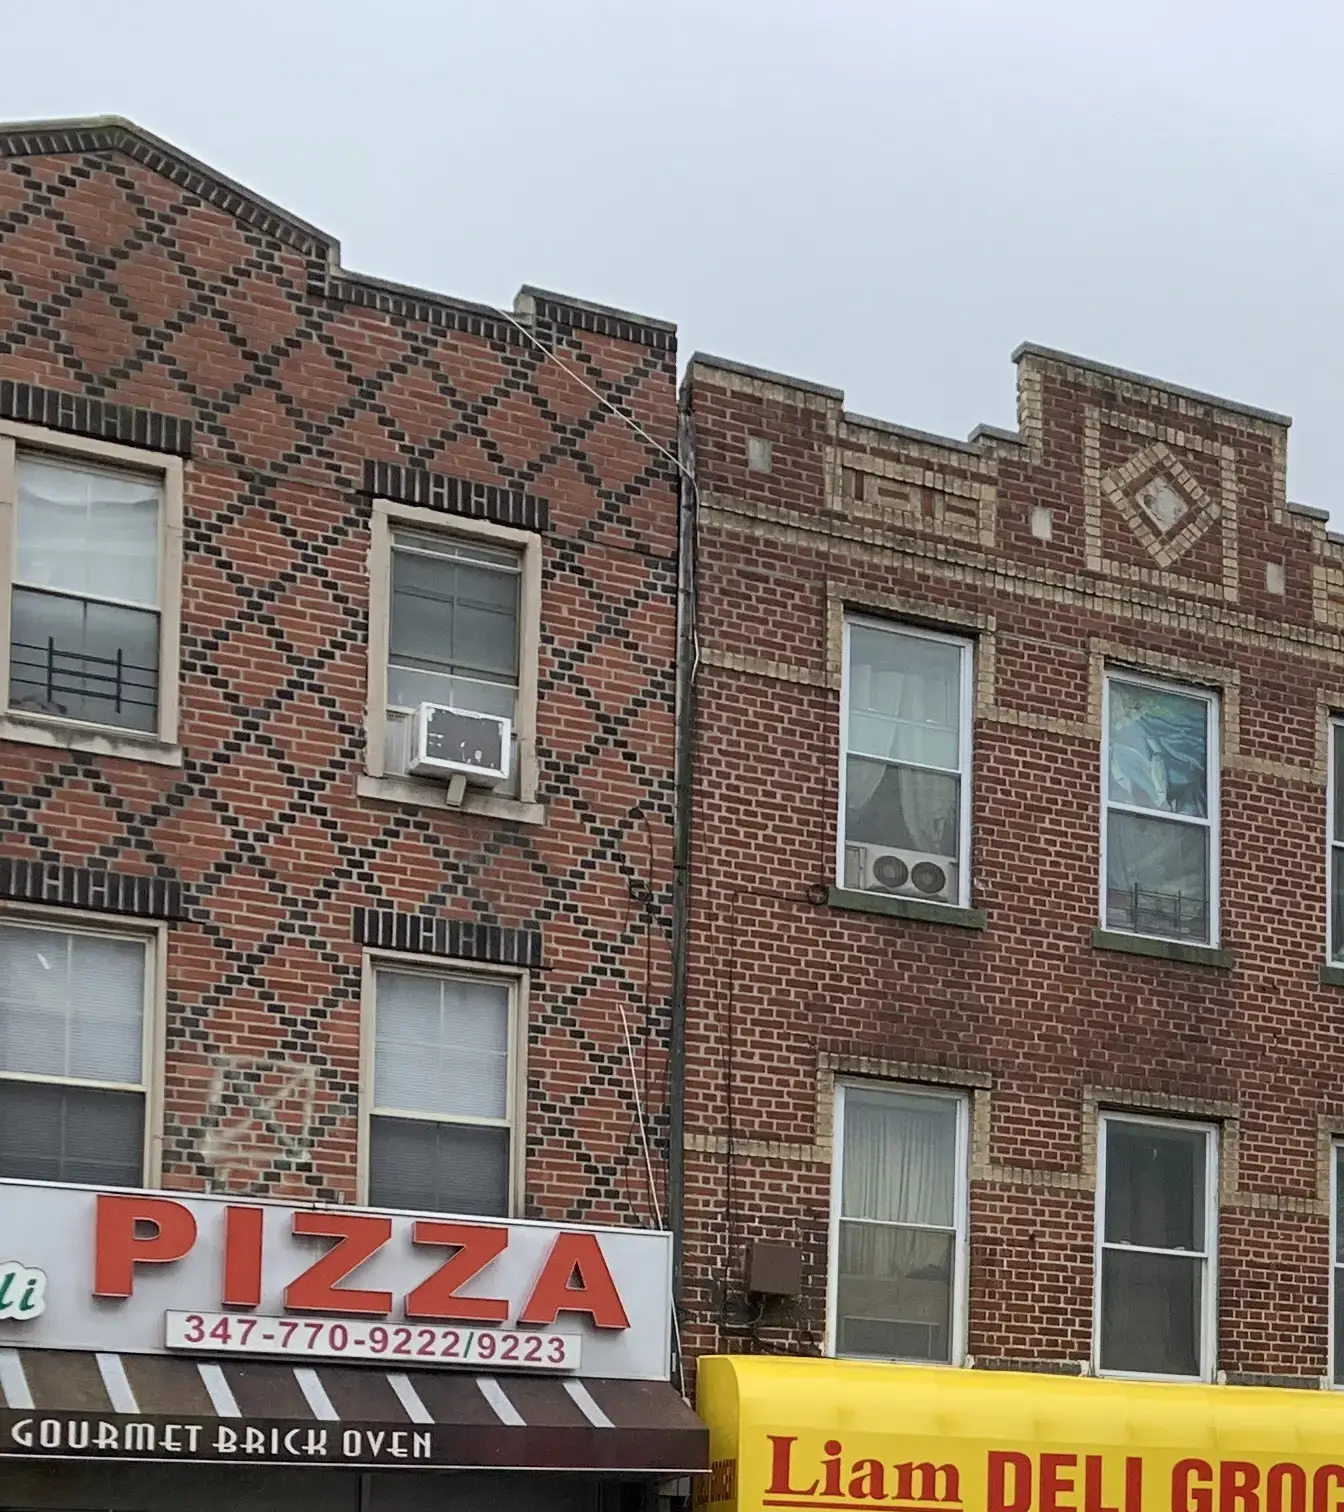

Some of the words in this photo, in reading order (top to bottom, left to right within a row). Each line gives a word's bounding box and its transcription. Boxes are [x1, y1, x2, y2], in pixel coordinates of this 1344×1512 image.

[92, 1194, 631, 1330] PIZZA
[184, 1314, 566, 1364] 347-770-9222/9223
[11, 1418, 202, 1453] GOURMET
[212, 1424, 327, 1456] BRICK
[343, 1429, 432, 1459] OVEN
[764, 1434, 962, 1504] Liam
